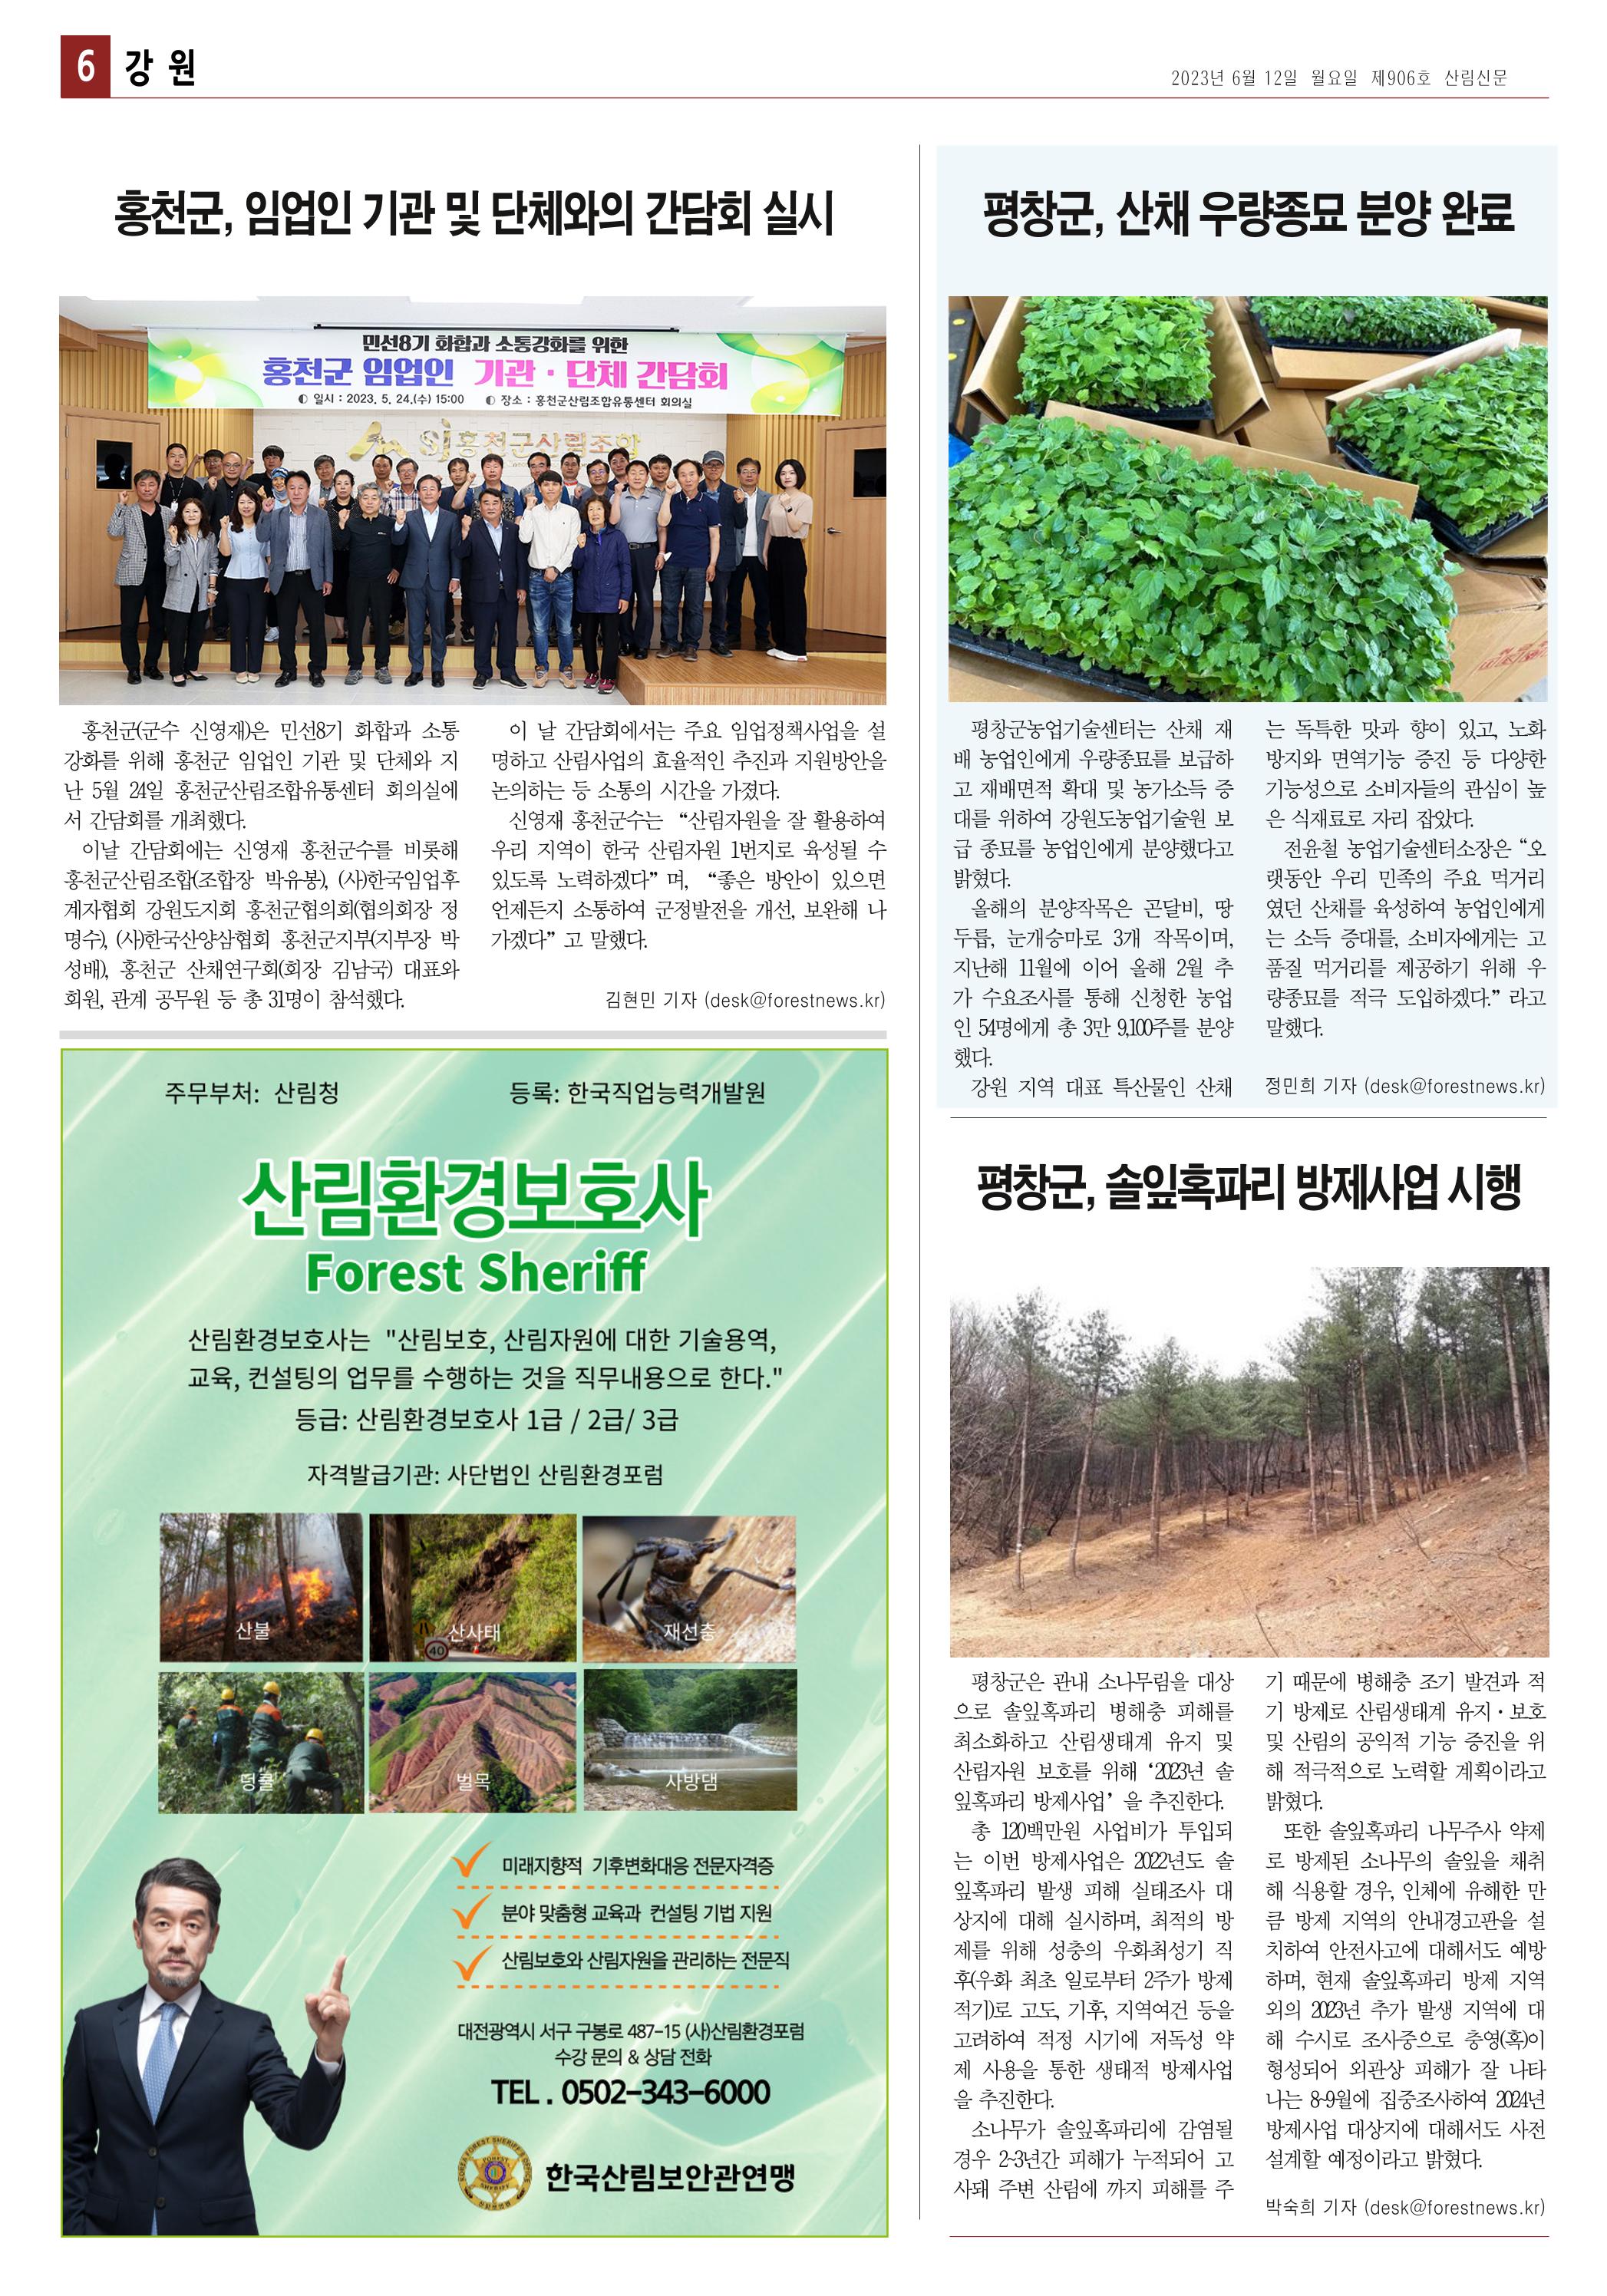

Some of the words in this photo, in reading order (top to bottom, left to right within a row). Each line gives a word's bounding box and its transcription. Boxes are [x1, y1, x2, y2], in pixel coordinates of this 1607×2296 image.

[78, 49, 95, 82] 6
[1172, 69, 1223, 87] 2023년
[1232, 69, 1255, 87] 6월
[1265, 69, 1296, 87] 12일
[1312, 69, 1357, 87] 월요일
[1371, 69, 1431, 87] 제906호
[1444, 69, 1507, 87] 산림신문
[114, 190, 233, 237] 홍천군,
[246, 190, 351, 236] 임업인
[363, 190, 436, 236] 기관
[447, 190, 481, 237] 및
[492, 190, 633, 236] 단체와의
[645, 190, 751, 236] 간담회
[763, 190, 833, 236] 실시
[983, 190, 1104, 239] 평창군,
[1116, 190, 1190, 237] 산채
[1199, 190, 1348, 238] 우량종묘
[1356, 190, 1432, 238] 분양
[1441, 190, 1516, 236] 완료
[362, 335, 430, 352] 민선8기
[435, 335, 491, 352] 화합과
[495, 335, 586, 354] 소통강화를
[592, 336, 629, 355] 위한
[263, 357, 352, 386] 홍천군
[363, 357, 454, 387] 임업인
[474, 359, 535, 388] 기관
[566, 360, 627, 389] 단체
[638, 361, 728, 391] 간담회
[81, 720, 180, 742] 홍천군(군수
[190, 720, 269, 741] 신영재)은
[280, 720, 342, 741] 민선8기
[354, 720, 411, 742] 화합과
[421, 721, 460, 741] 소통
[971, 718, 1157, 741] 평창군농업기술센터는
[1166, 718, 1202, 740] 산채
[1214, 718, 1232, 741] 재
[64, 780, 84, 800] 난
[92, 780, 119, 800] 5월
[129, 780, 163, 800] 24일
[174, 780, 374, 802] 홍천군산림조합유통센터
[385, 780, 457, 801] 회의실에
[1284, 838, 1338, 859] 전윤철
[1346, 838, 1512, 860] 농업기술센터소장은
[1520, 837, 1547, 857] “오
[606, 991, 655, 1009] 김현민
[663, 991, 698, 1009] 기자
[705, 991, 885, 1010] (desk@forestnews.kr)
[165, 1081, 259, 1105] 주무부처:
[274, 1081, 338, 1105] 산림청
[510, 1081, 559, 1105] 등록:
[568, 1081, 765, 1105] 한국직업능력개발원
[971, 1077, 1008, 1099] 강원
[1018, 1077, 1054, 1098] 지역
[1066, 1077, 1104, 1098] 대표
[1113, 1077, 1186, 1098] 특산물인
[1196, 1077, 1232, 1098] 산채
[1265, 1077, 1315, 1095] 정민희
[1323, 1077, 1357, 1095] 기자
[1364, 1077, 1545, 1096] (desk@forestnews.kr)
[977, 1163, 1095, 1212] 평창군,
[1105, 1163, 1285, 1211] 솔잎혹파리
[1297, 1163, 1438, 1212] 방제사업
[1447, 1163, 1521, 1212] 시행
[243, 1160, 708, 1239] 산림환경보호사
[309, 1254, 463, 1292] Forest
[480, 1249, 648, 1292] Sheriff
[188, 1328, 371, 1352] 산림환경보호사는
[387, 1328, 495, 1354] "산림보호,
[503, 1328, 616, 1352] 산림자원에
[626, 1328, 671, 1352] 대한
[679, 1328, 776, 1354] 기술용역,
[188, 1366, 239, 1393] 교육,
[249, 1366, 337, 1390] 컨설팅의
[347, 1366, 414, 1390] 업무를
[423, 1366, 513, 1390] 수행하는
[523, 1366, 566, 1390] 것을
[575, 1366, 711, 1390] 직무내용으로
[720, 1366, 782, 1390] 한다."
[295, 1408, 348, 1432] 등급:
[356, 1407, 519, 1432] 산림환경보호사
[527, 1408, 563, 1432] 1급
[642, 1408, 679, 1432] 3급
[308, 1463, 439, 1486] 자격발급기관:
[447, 1463, 530, 1486] 사단법인
[538, 1463, 662, 1486] 산림환경포럼
[236, 1621, 270, 1641] 산불
[447, 1623, 501, 1643] 산사태
[663, 1622, 716, 1642] 재선충
[429, 1646, 444, 1656] 40
[971, 1671, 1045, 1693] 평창군은
[1052, 1671, 1087, 1693] 관내
[1097, 1671, 1190, 1693] 소나무림을
[1197, 1671, 1235, 1693] 대상
[240, 1773, 275, 1792] 덩쿨
[457, 1773, 491, 1792] 벌목
[665, 1773, 718, 1792] 사방댐
[1283, 1820, 1322, 1841] 또한
[1328, 1820, 1417, 1842] 솔잎혹파리
[1428, 1820, 1502, 1842] 나무주사
[1510, 1820, 1544, 1842] 약제
[503, 1856, 582, 1876] 미래지향적
[592, 1856, 689, 1876] 기후변화대응
[693, 1856, 774, 1876] 전문자격증
[501, 1904, 536, 1923] 분야
[540, 1903, 587, 1923] 맞춤형
[592, 1903, 642, 1923] 교육과
[650, 1903, 698, 1923] 컨설팅
[703, 1904, 734, 1923] 기법
[739, 1904, 772, 1923] 지원
[502, 1951, 584, 1970] 산림보호와
[586, 1951, 668, 1970] 산림자원을
[672, 1951, 738, 1970] 관리하는
[741, 1951, 790, 1971] 전문직
[458, 2022, 535, 2041] 대전광역시
[540, 2022, 573, 2041] 서구
[576, 2023, 624, 2041] 구봉로
[627, 2024, 681, 2039] 487-15
[685, 2022, 804, 2041] (사)산림환경포럼
[555, 2048, 588, 2067] 수강
[591, 2048, 622, 2067] 문의
[628, 2049, 639, 2065] &
[644, 2047, 677, 2067] 상담
[679, 2047, 713, 2067] 전화
[562, 2079, 771, 2105] 0502-343-6000
[1265, 2149, 1322, 2170] 설계할
[1328, 2149, 1419, 2170] 예정이라고
[1425, 2149, 1483, 2170] 밝혔다.
[546, 2162, 795, 2193] 한국산림보안관연맹
[1266, 2198, 1315, 2217] 박숙희
[1323, 2198, 1358, 2216] 기자
[1364, 2198, 1545, 2217] (desk@forestnews.kr)
